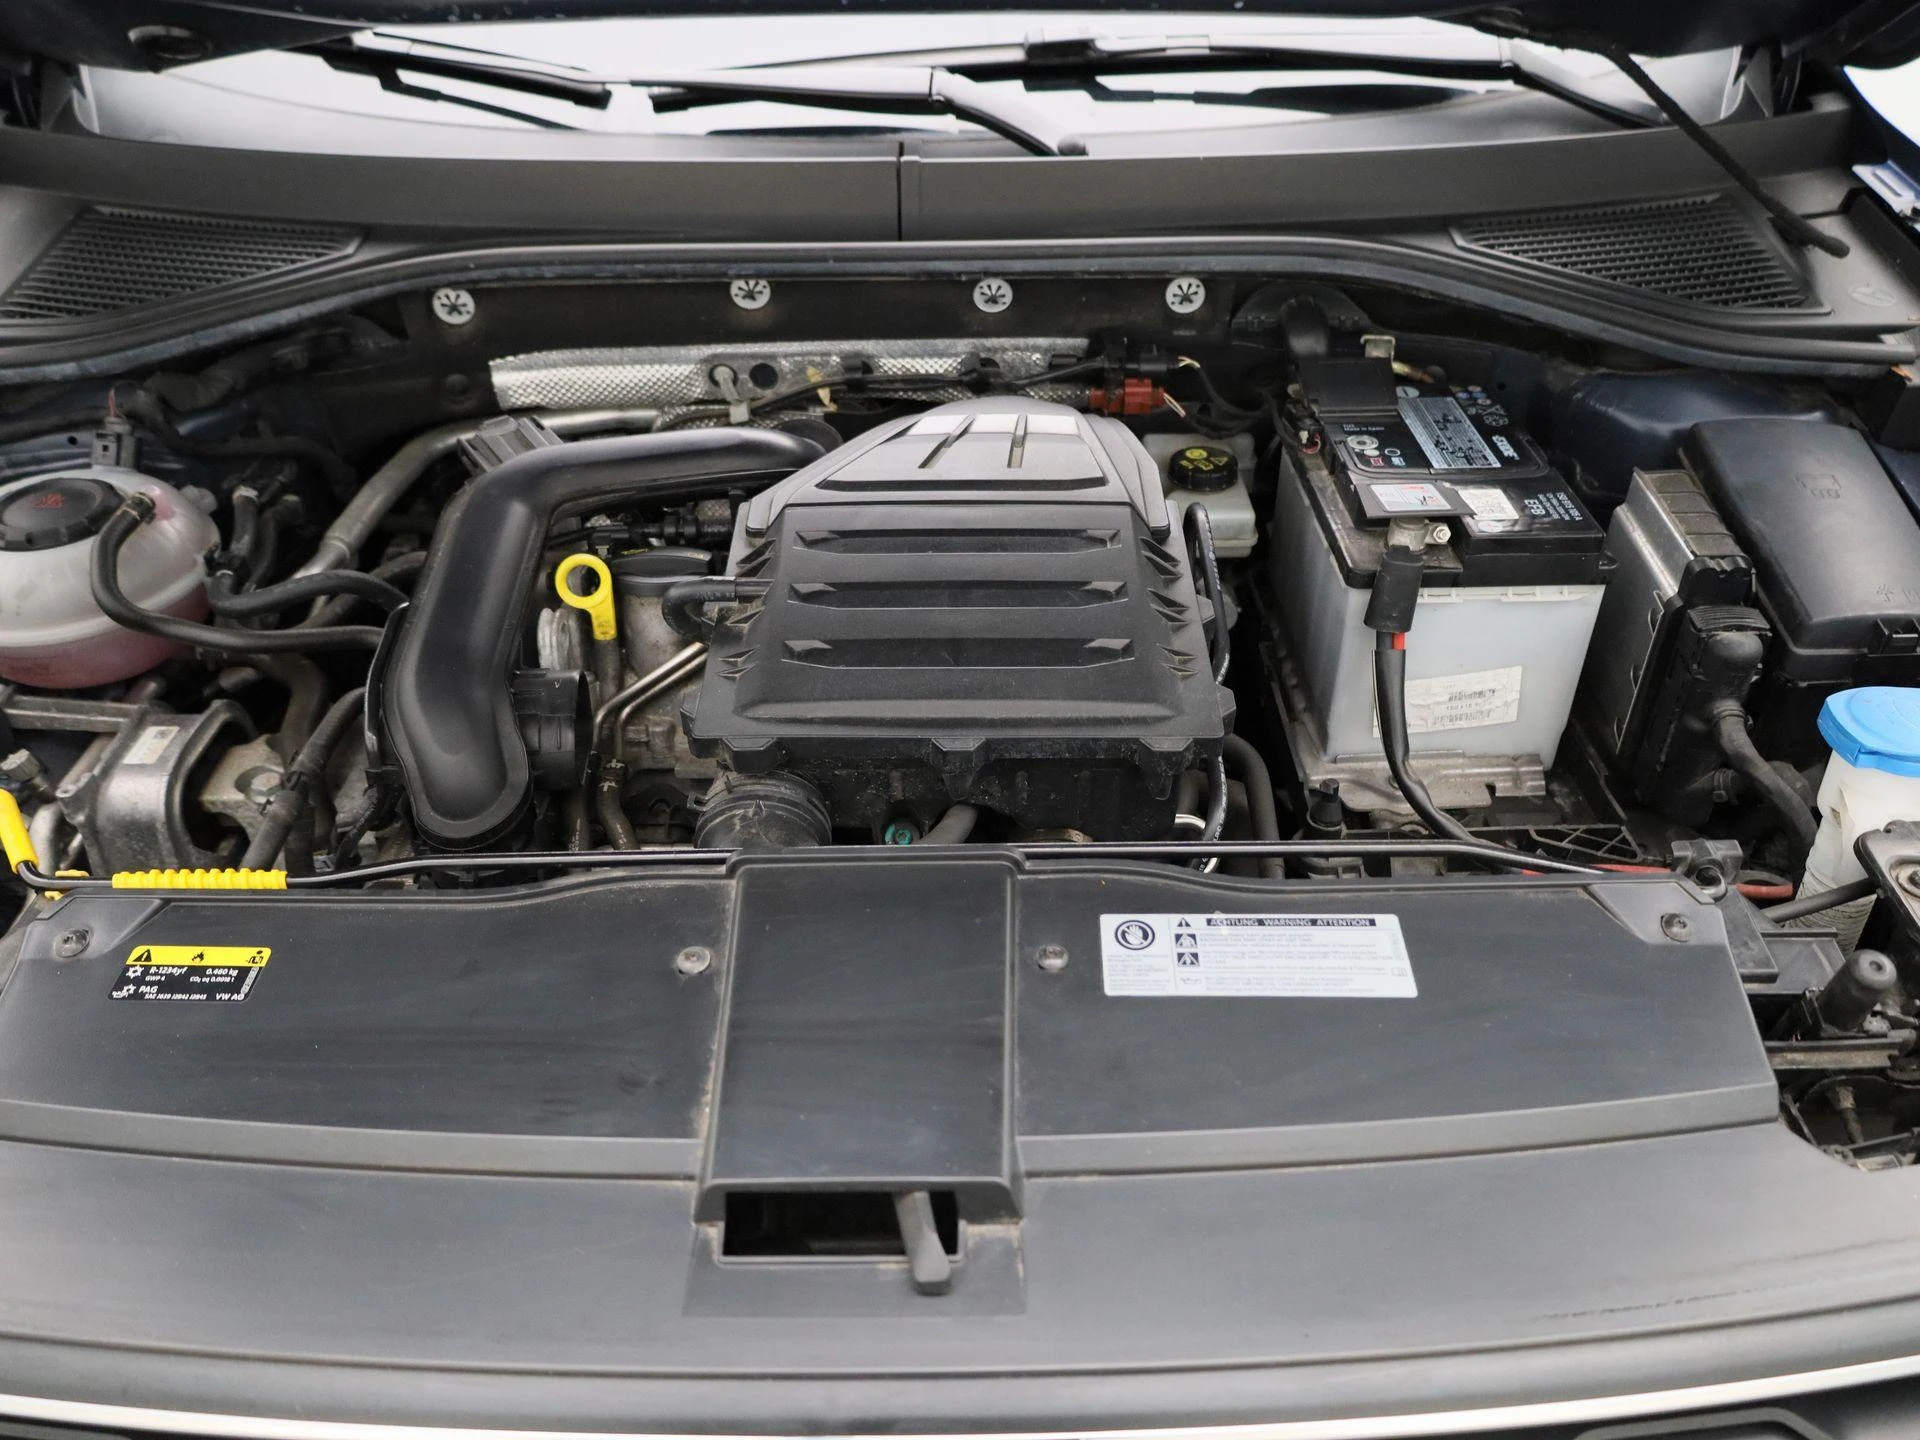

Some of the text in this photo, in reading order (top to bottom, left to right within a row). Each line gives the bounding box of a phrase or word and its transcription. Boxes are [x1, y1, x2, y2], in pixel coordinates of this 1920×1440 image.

[1524, 500, 1546, 515] EFB
[1210, 918, 1370, 926] ACHTUNG WARNING ATTENTION
[149, 966, 188, 976] R-1234yf
[228, 968, 239, 977] kg
[139, 985, 159, 994] PAG
[230, 993, 245, 1001] AG
